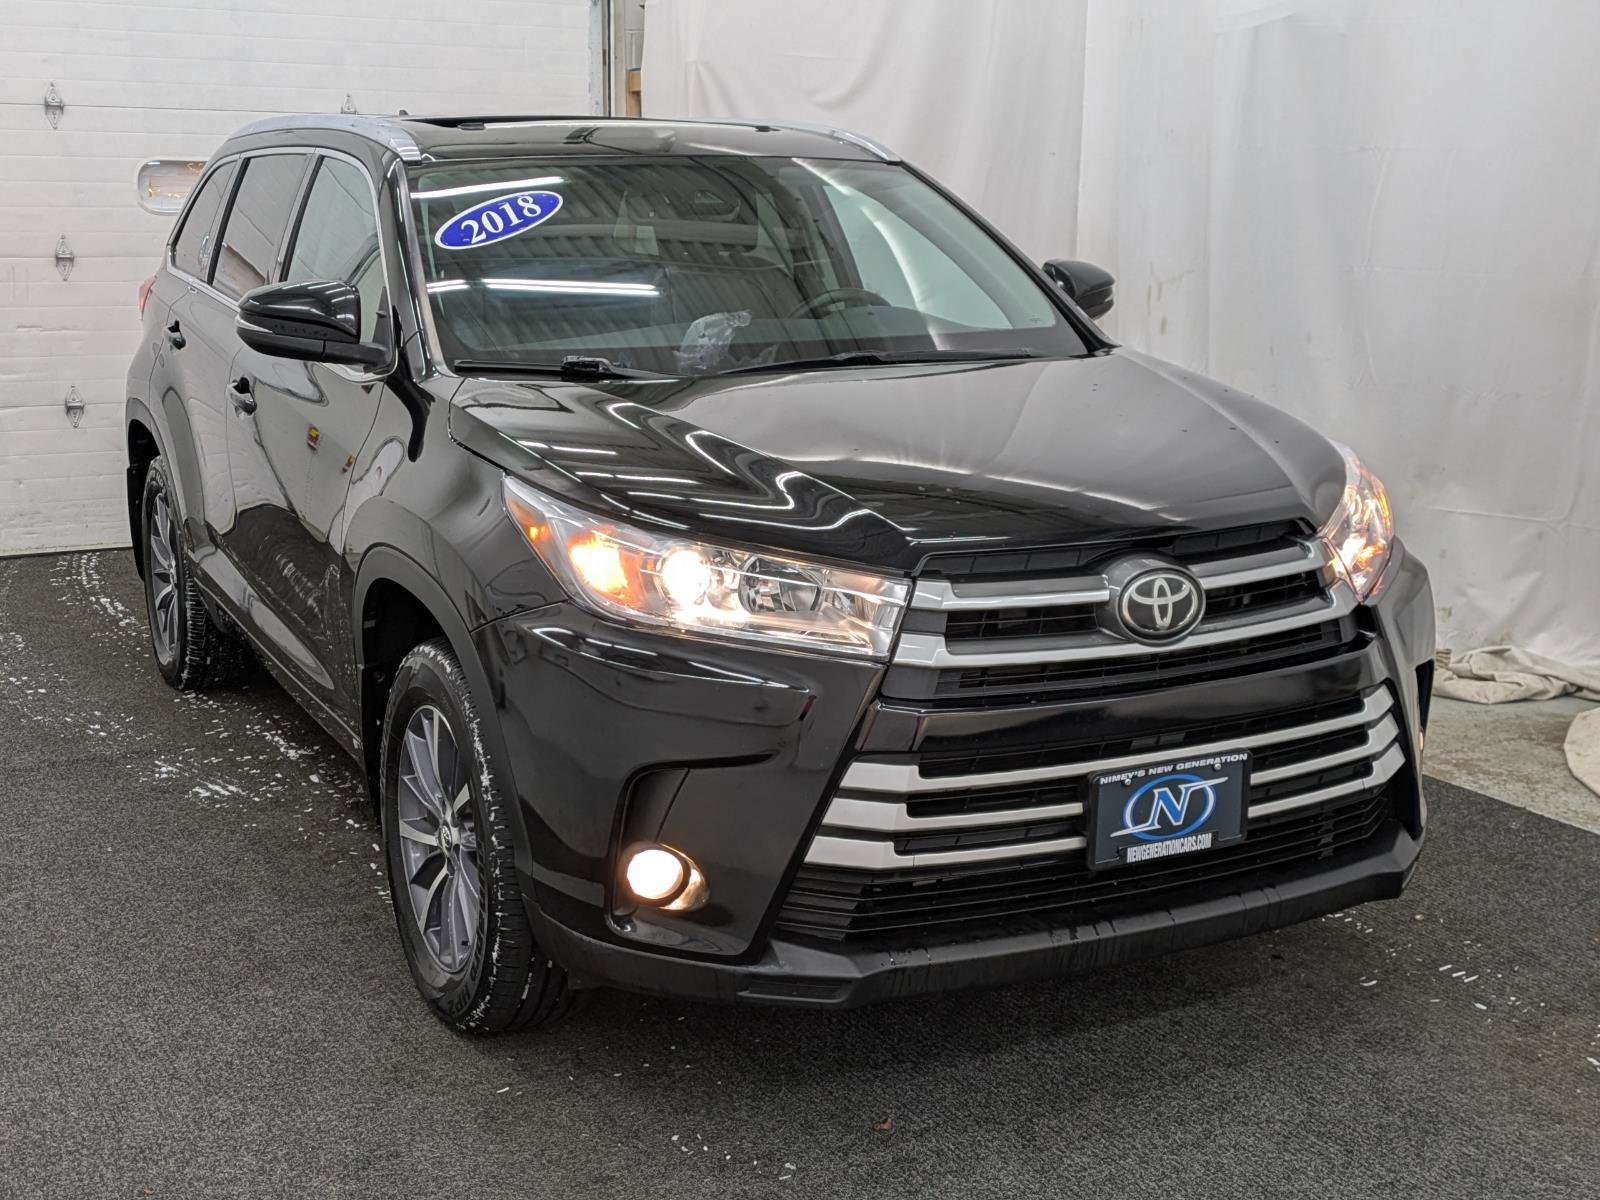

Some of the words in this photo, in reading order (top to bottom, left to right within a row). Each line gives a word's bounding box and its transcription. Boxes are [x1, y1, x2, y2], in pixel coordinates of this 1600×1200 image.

[461, 195, 541, 244] 2018
[1100, 769, 1146, 785] NIMEY'S
[1148, 764, 1174, 776] NEW
[1176, 753, 1248, 771] GENERATION
[1126, 832, 1212, 863] NEWGENERATIONCARS.COM
